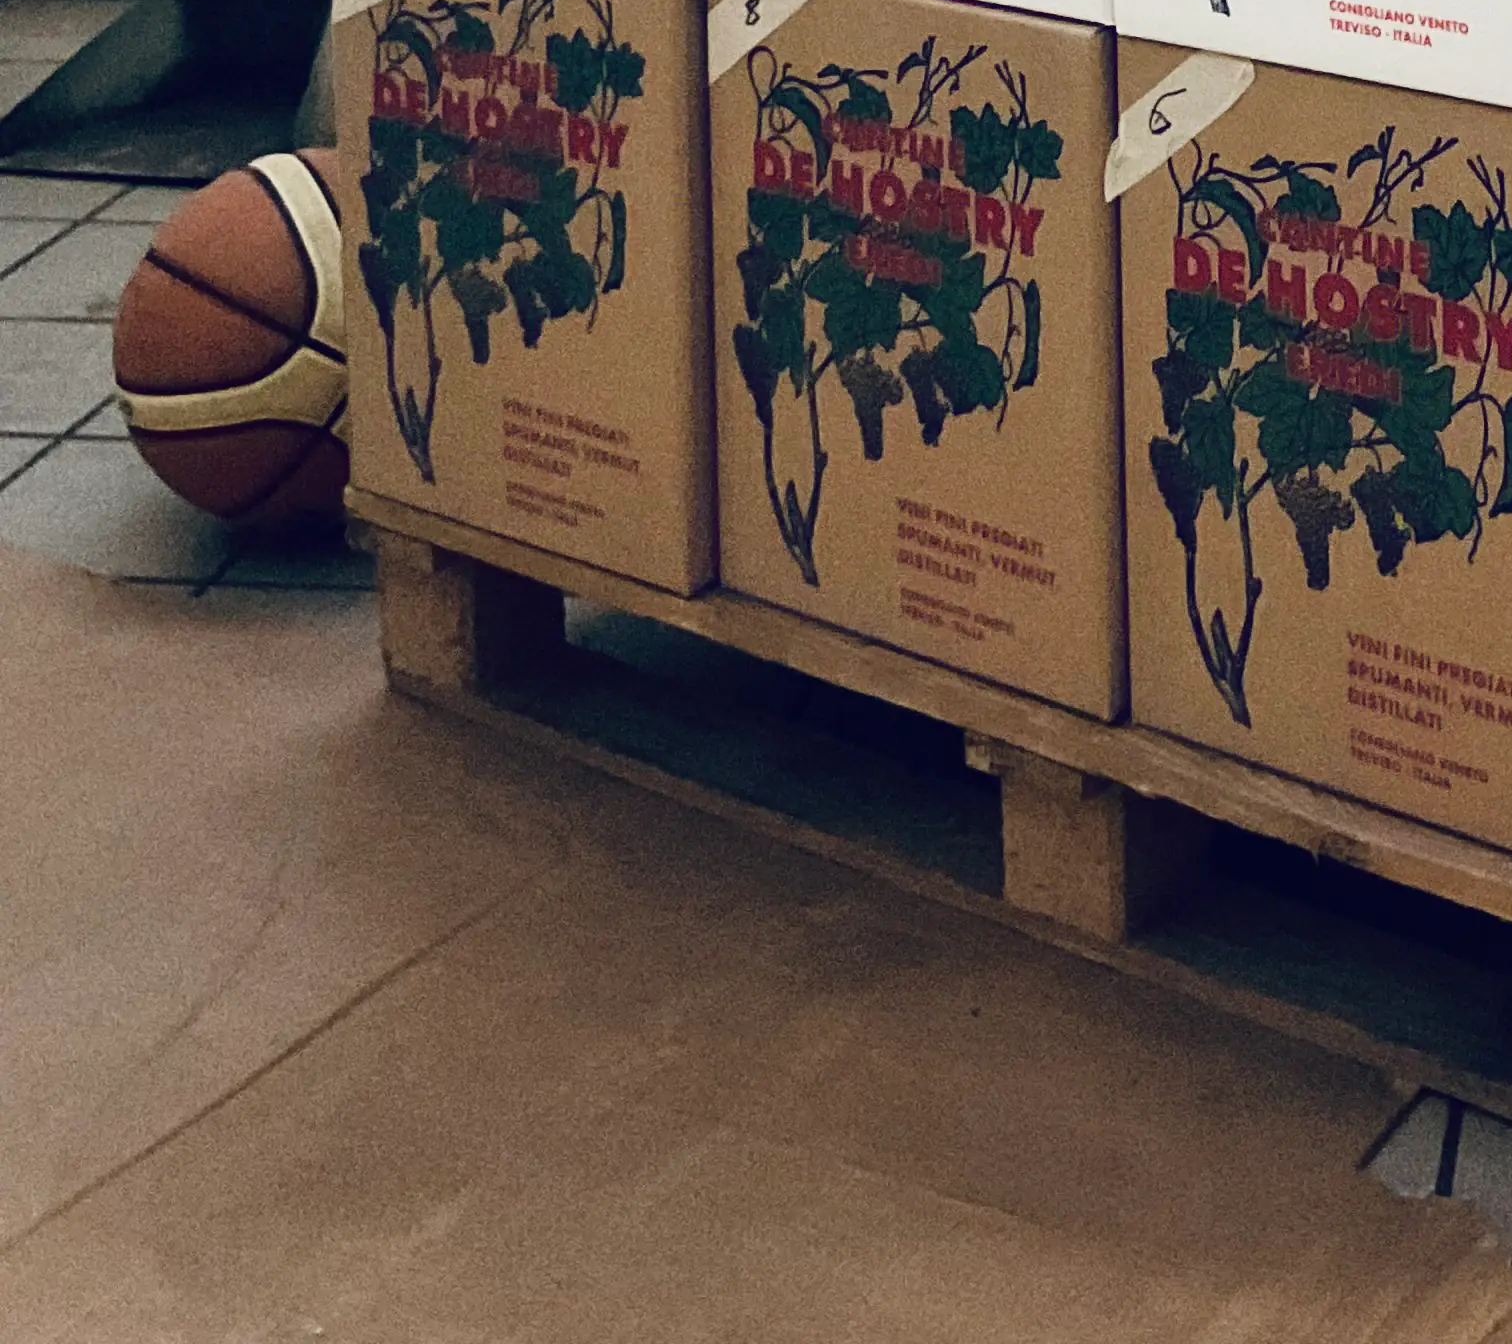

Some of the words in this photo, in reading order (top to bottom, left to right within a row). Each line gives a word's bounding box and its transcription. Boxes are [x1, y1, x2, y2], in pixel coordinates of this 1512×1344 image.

[1329, 0, 1415, 25] CONEGLIANO
[1418, 15, 1470, 35] VENETO
[1329, 18, 1382, 38] TREVISO
[1393, 29, 1433, 48] ITALIA
[373, 72, 429, 127] DE
[753, 138, 815, 199] DE
[830, 158, 1046, 257] HOSTRY
[1173, 235, 1247, 305] DE
[1258, 206, 1432, 285] CANTINE
[1347, 630, 1388, 660] VINI
[1348, 686, 1442, 732] DISTILLATI
